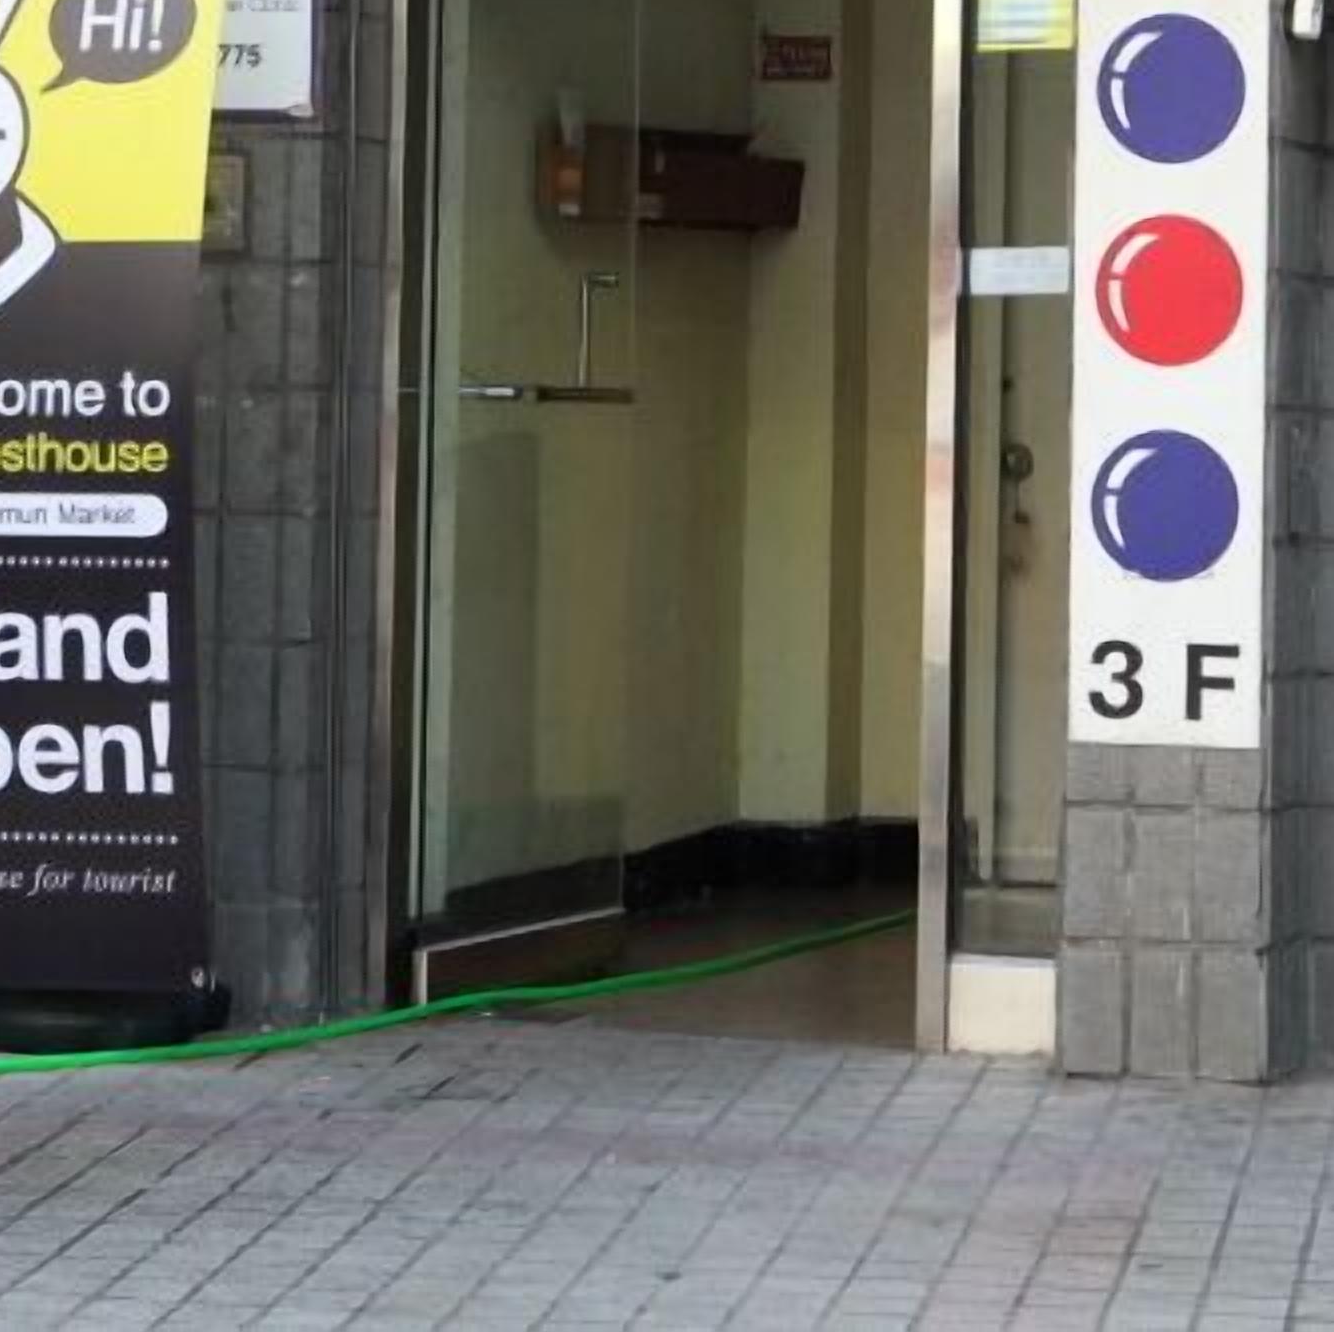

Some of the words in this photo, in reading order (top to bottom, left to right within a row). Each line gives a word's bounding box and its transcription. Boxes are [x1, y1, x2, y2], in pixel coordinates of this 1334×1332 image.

[121, 370, 171, 418] to
[58, 503, 137, 526] Market
[29, 864, 75, 896] for
[82, 866, 177, 894] tourist
